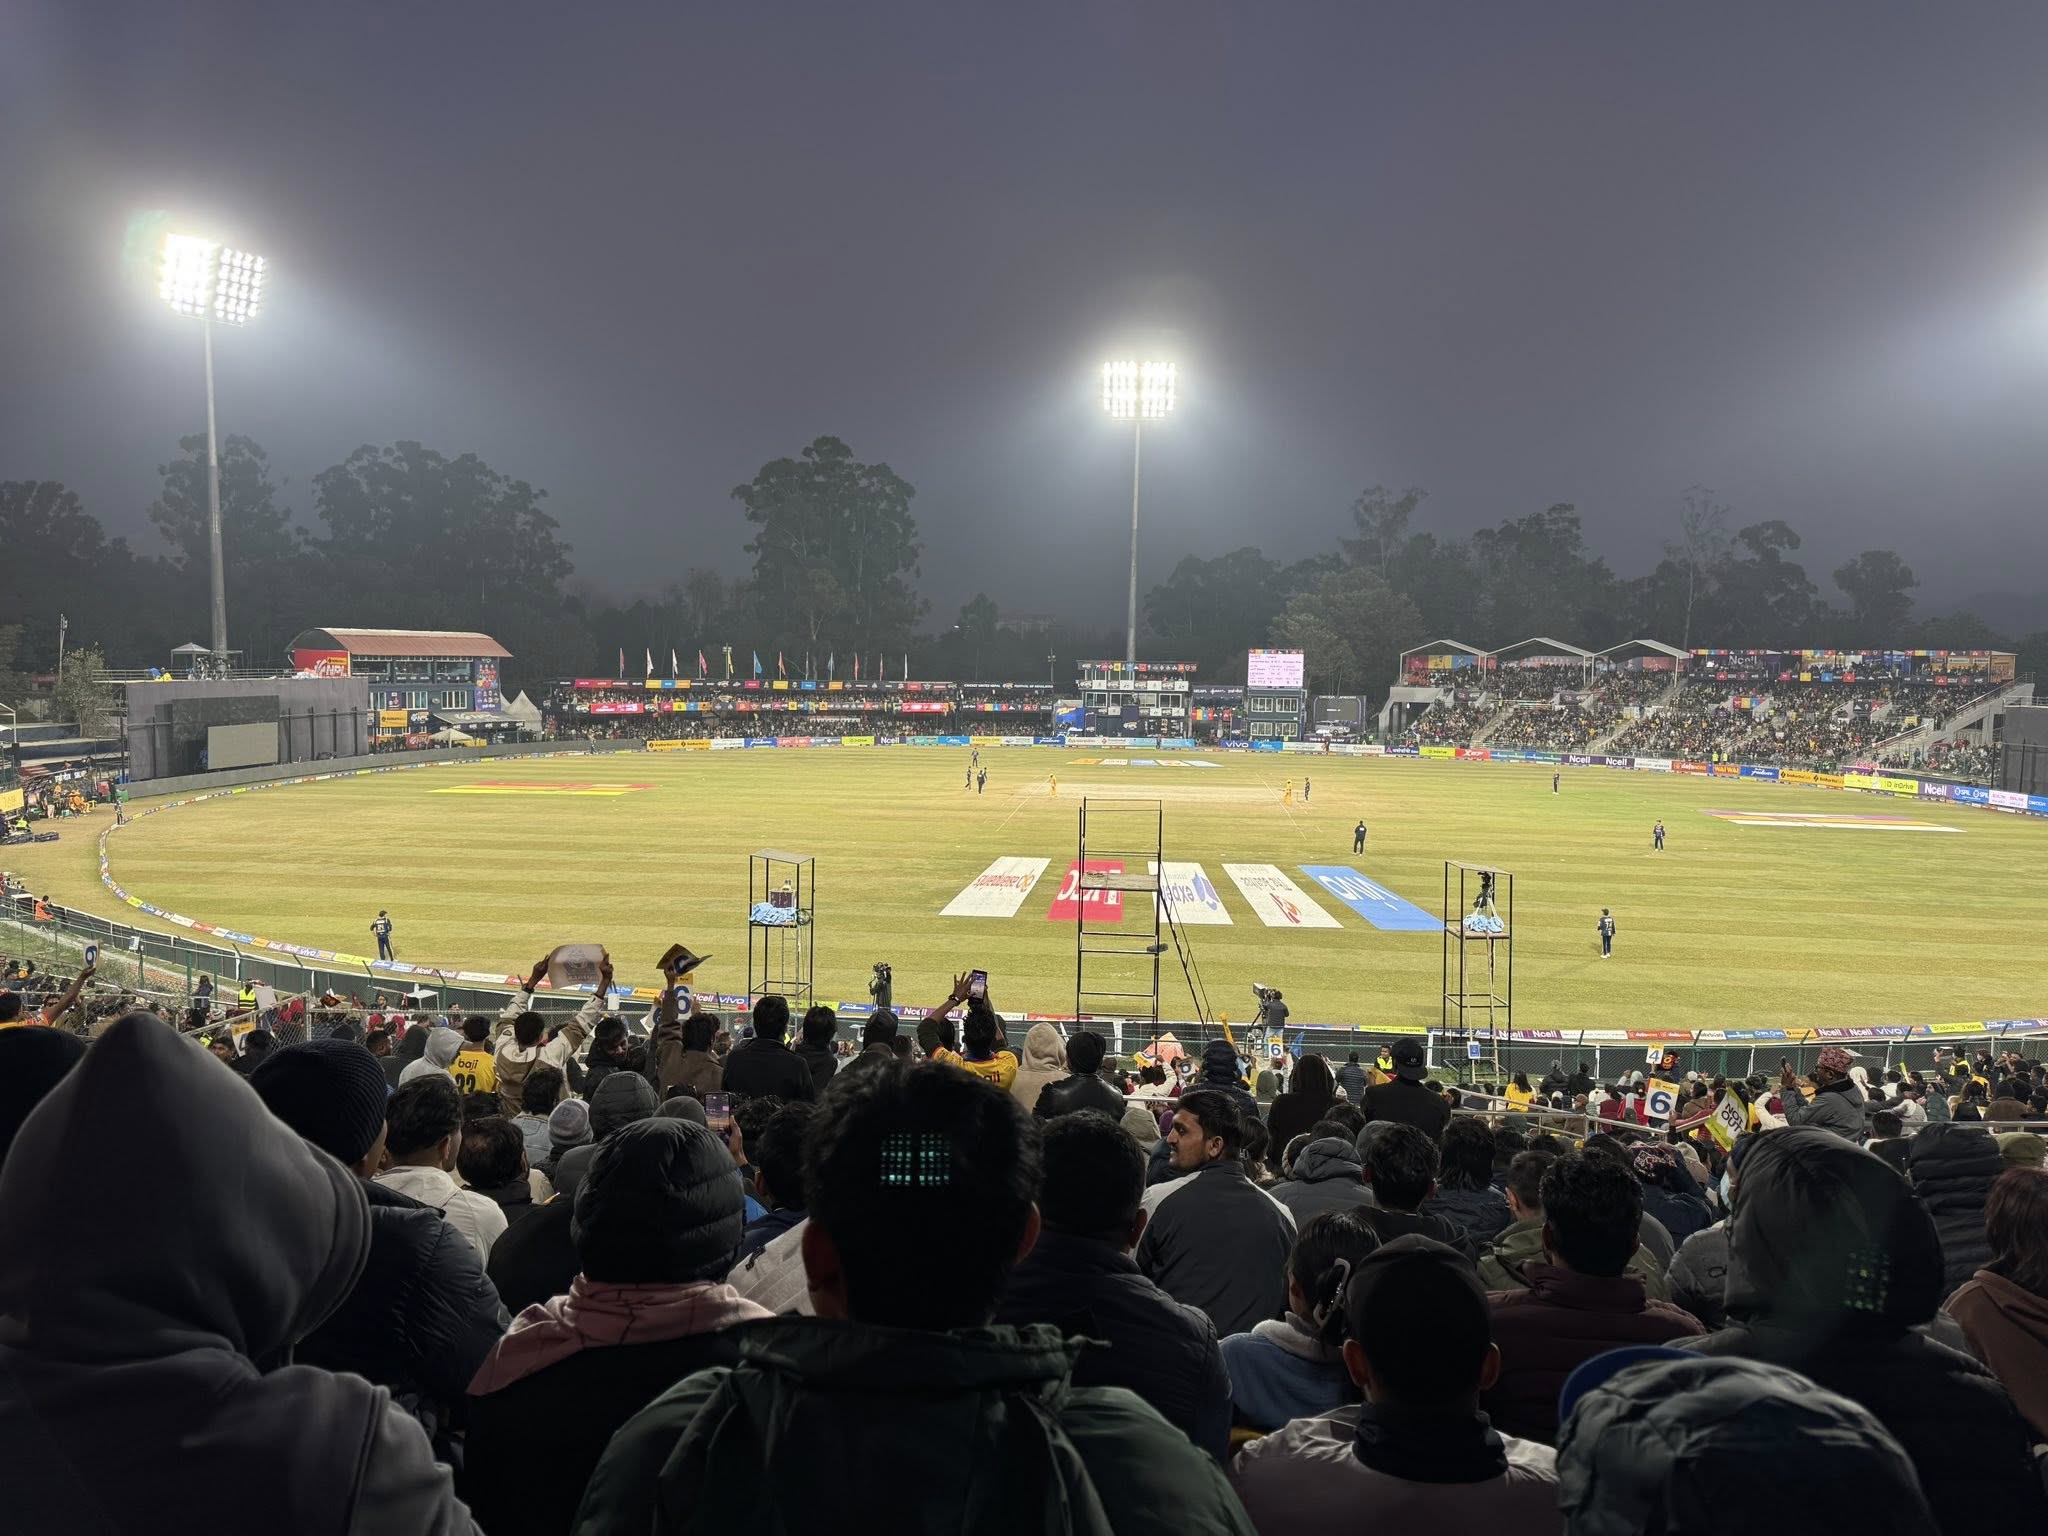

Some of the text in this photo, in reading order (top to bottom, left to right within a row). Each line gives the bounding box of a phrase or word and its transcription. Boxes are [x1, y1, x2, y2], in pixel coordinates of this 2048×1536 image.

[880, 736, 900, 745] Ncell
[1225, 740, 1249, 749] vivo
[1569, 754, 1591, 764] Ncell
[1605, 757, 1628, 767] Ncell
[1924, 783, 1948, 796] Ncell
[414, 966, 433, 975] Ncell
[674, 985, 691, 1014] 6
[719, 996, 745, 1005] vivo
[903, 1006, 928, 1016] Ncell
[1498, 1030, 1524, 1039] Ncell
[1532, 1030, 1558, 1039] Ncell
[1818, 1027, 1842, 1037] Ncell
[1849, 1027, 1873, 1037] Ncell
[1876, 1027, 1902, 1036] vivo
[1270, 1043, 1281, 1056] 6
[1648, 1049, 1660, 1062] 4
[458, 1058, 479, 1071] baji
[1650, 1091, 1672, 1114] 6
[1724, 1103, 1744, 1125] NOT
[1720, 1110, 1741, 1132] OUT
